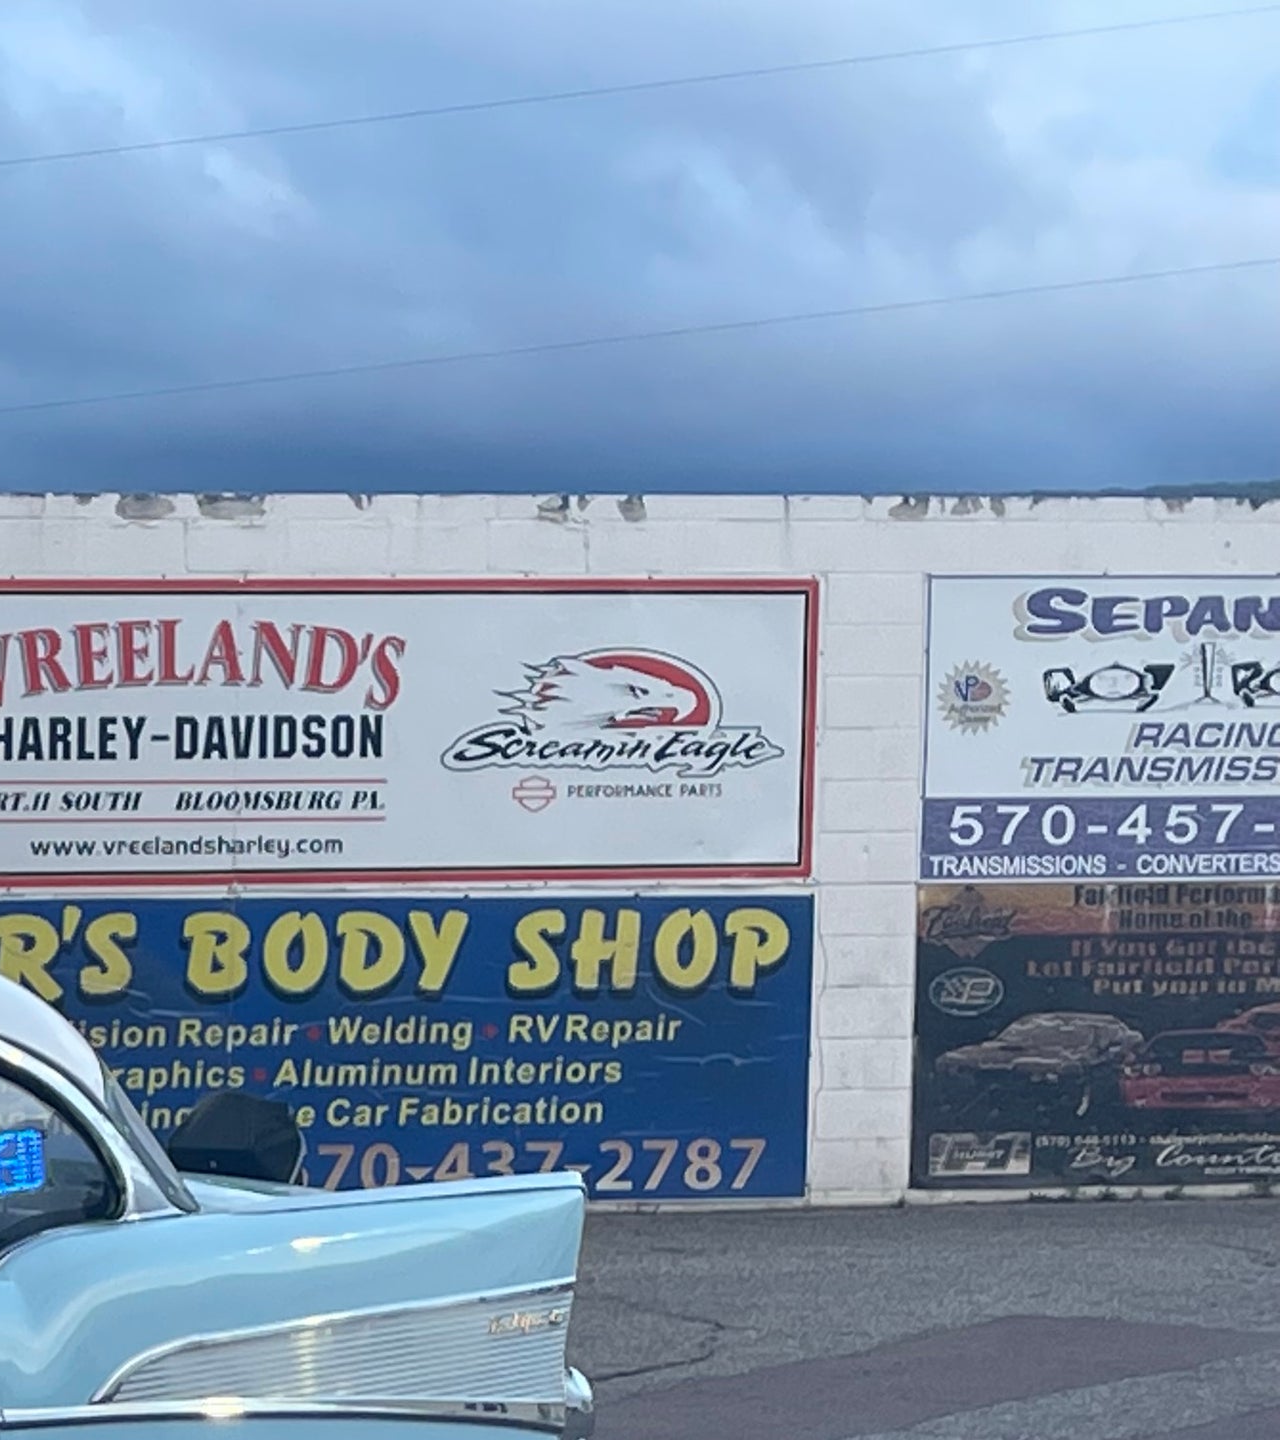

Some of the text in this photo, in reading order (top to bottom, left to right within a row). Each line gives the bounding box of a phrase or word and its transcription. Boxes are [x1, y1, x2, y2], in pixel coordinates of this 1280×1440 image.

[653, 731, 766, 771] Eagle
[59, 791, 144, 812] SOUTH
[176, 790, 343, 812] BLOOMSBURG
[567, 783, 723, 799] PERFORMANCE PARTS
[30, 834, 344, 857] www.vreelandsharley.com
[930, 855, 1107, 876] TRANSMISSIONS
[183, 907, 470, 995] BODY
[507, 907, 792, 993] SHOP
[177, 1016, 298, 1052] Repair
[328, 1015, 474, 1051] Welding
[508, 1014, 561, 1043] RV
[563, 1013, 683, 1048] Repair
[110, 1055, 624, 1097] raphics Aluminum Interiors
[325, 1097, 390, 1128] Car
[397, 1096, 606, 1128] Fabrication
[300, 1138, 769, 1192] 70-437-2787
